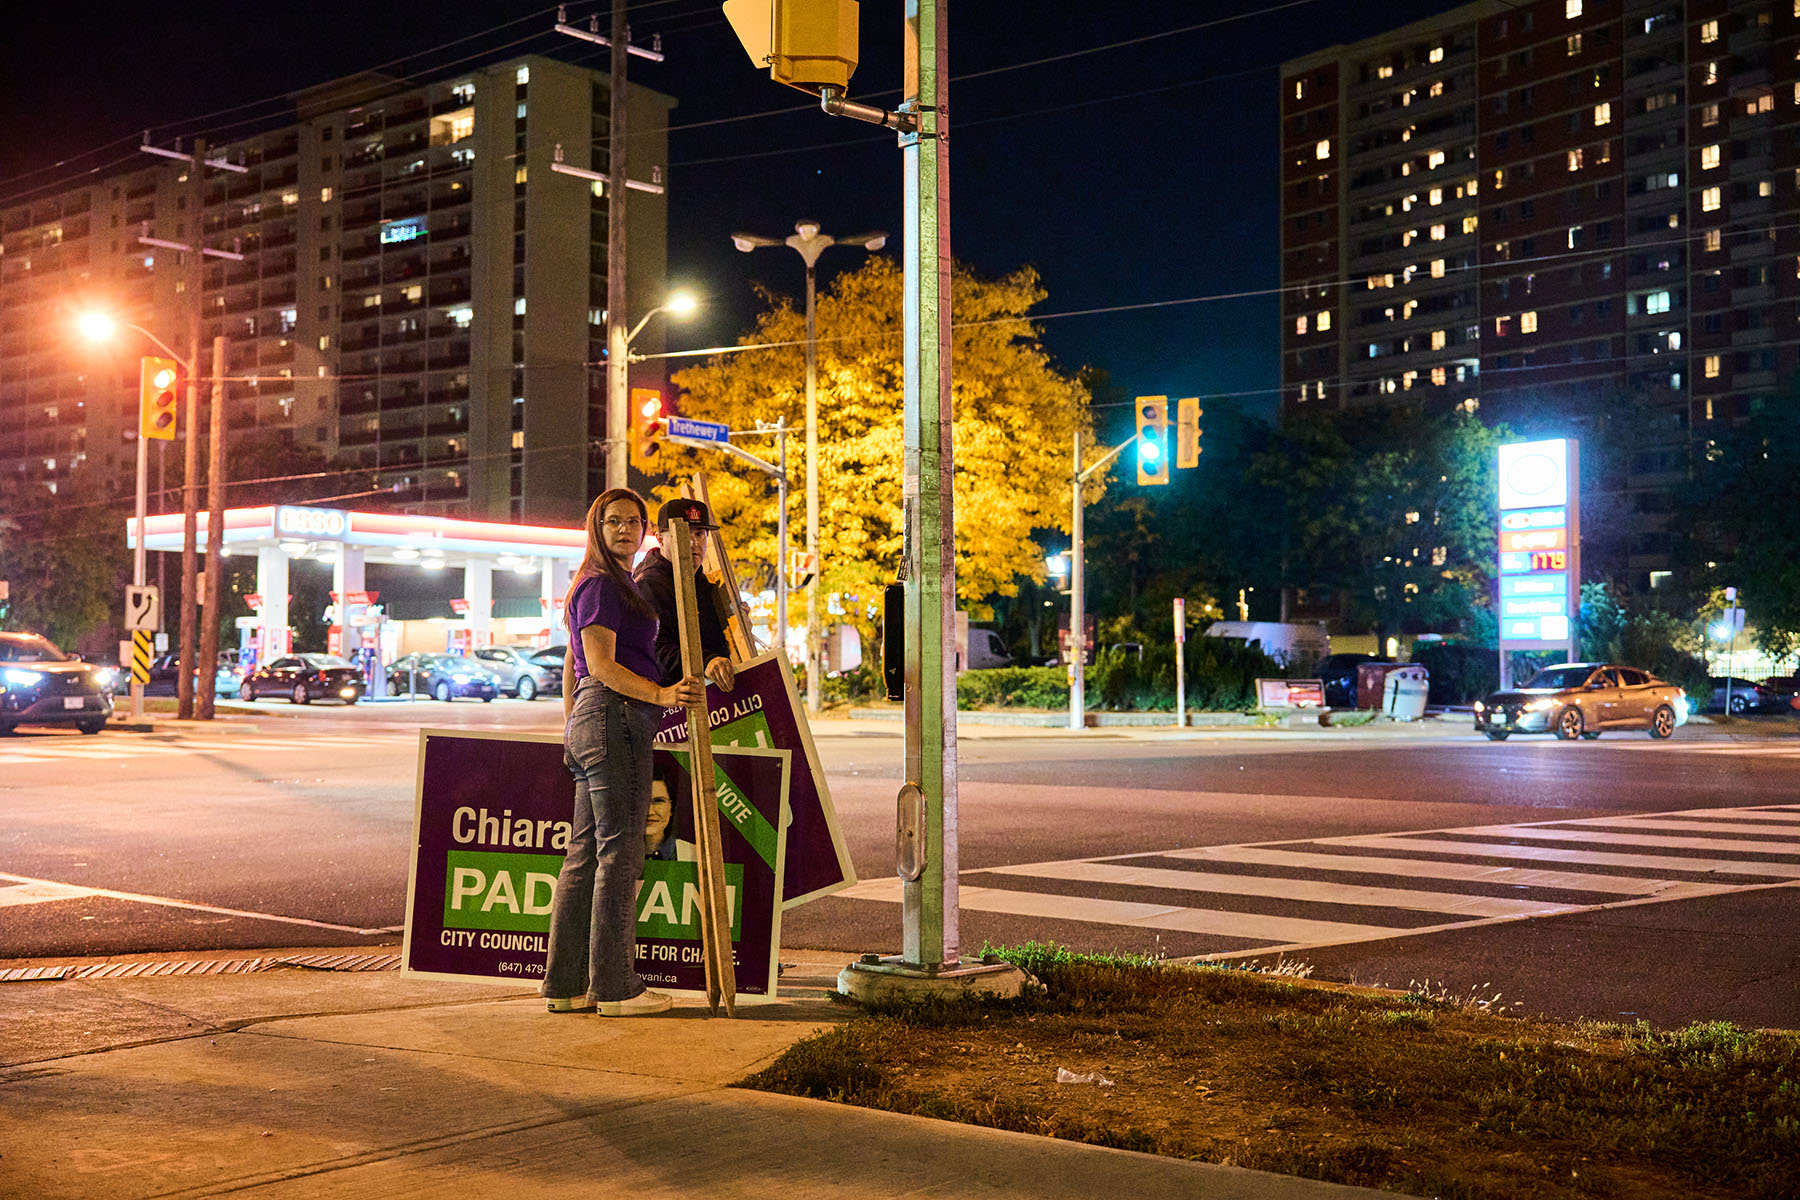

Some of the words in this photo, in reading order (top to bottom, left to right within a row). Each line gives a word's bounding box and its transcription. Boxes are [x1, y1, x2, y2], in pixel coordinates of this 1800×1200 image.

[672, 419, 718, 440] Trethewey
[733, 694, 763, 718] CITY
[716, 782, 752, 824] VOTE
[452, 806, 572, 850] Chiara
[451, 867, 736, 929] PADANI
[440, 929, 476, 948] CITY
[480, 932, 550, 953] COUNCIL
[651, 945, 678, 962] FOR
[498, 961, 523, 974] (647)
[525, 963, 548, 974] 479-
